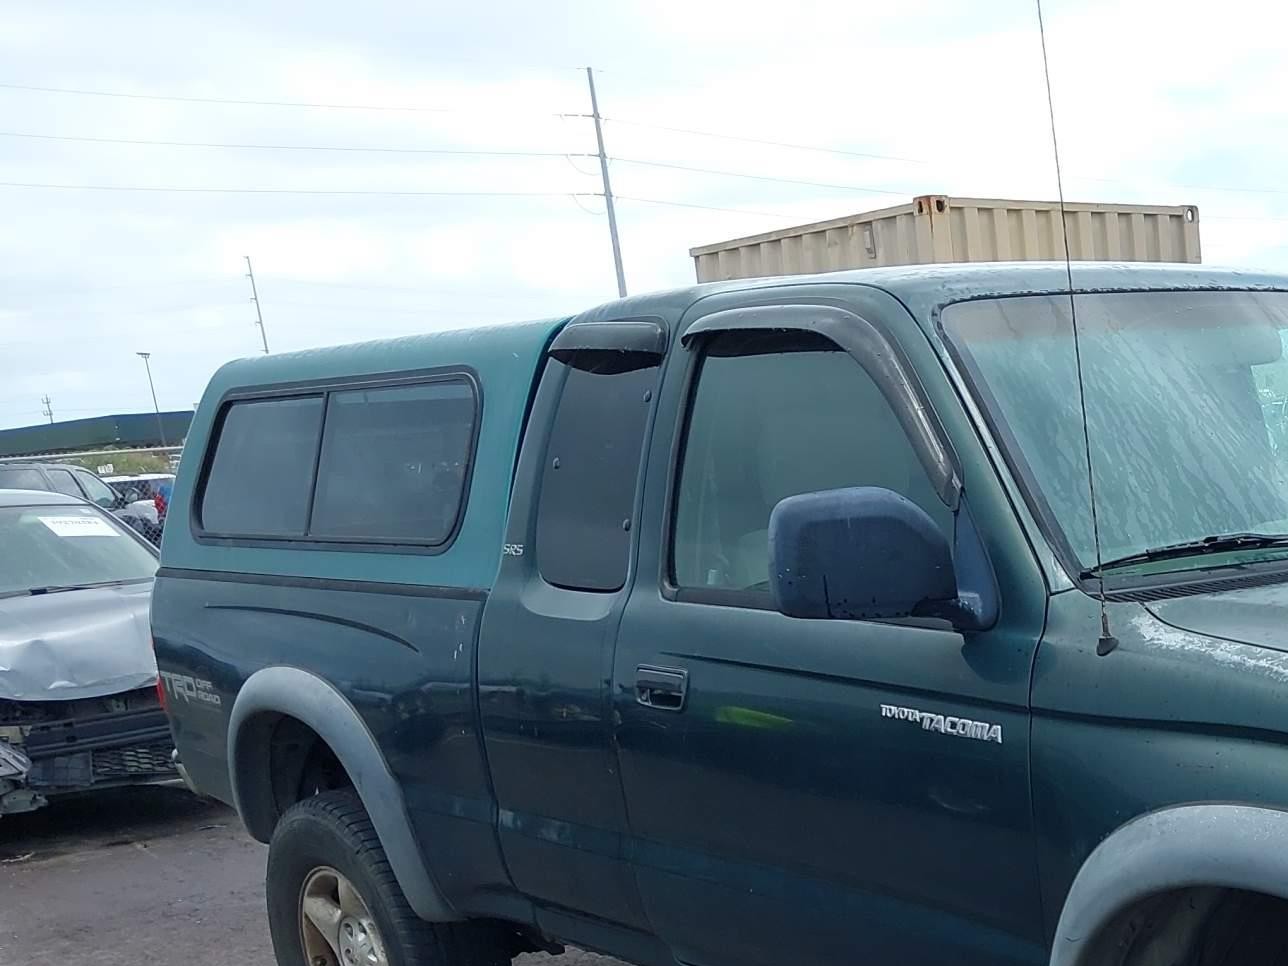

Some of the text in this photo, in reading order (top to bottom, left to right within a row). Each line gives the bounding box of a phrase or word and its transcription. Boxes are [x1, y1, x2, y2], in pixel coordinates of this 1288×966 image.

[503, 543, 524, 556] SRS
[160, 670, 197, 703] TRD
[195, 679, 213, 690] OFF
[197, 690, 221, 705] ROAD
[880, 704, 1002, 743] TOYOTA TACOMA
